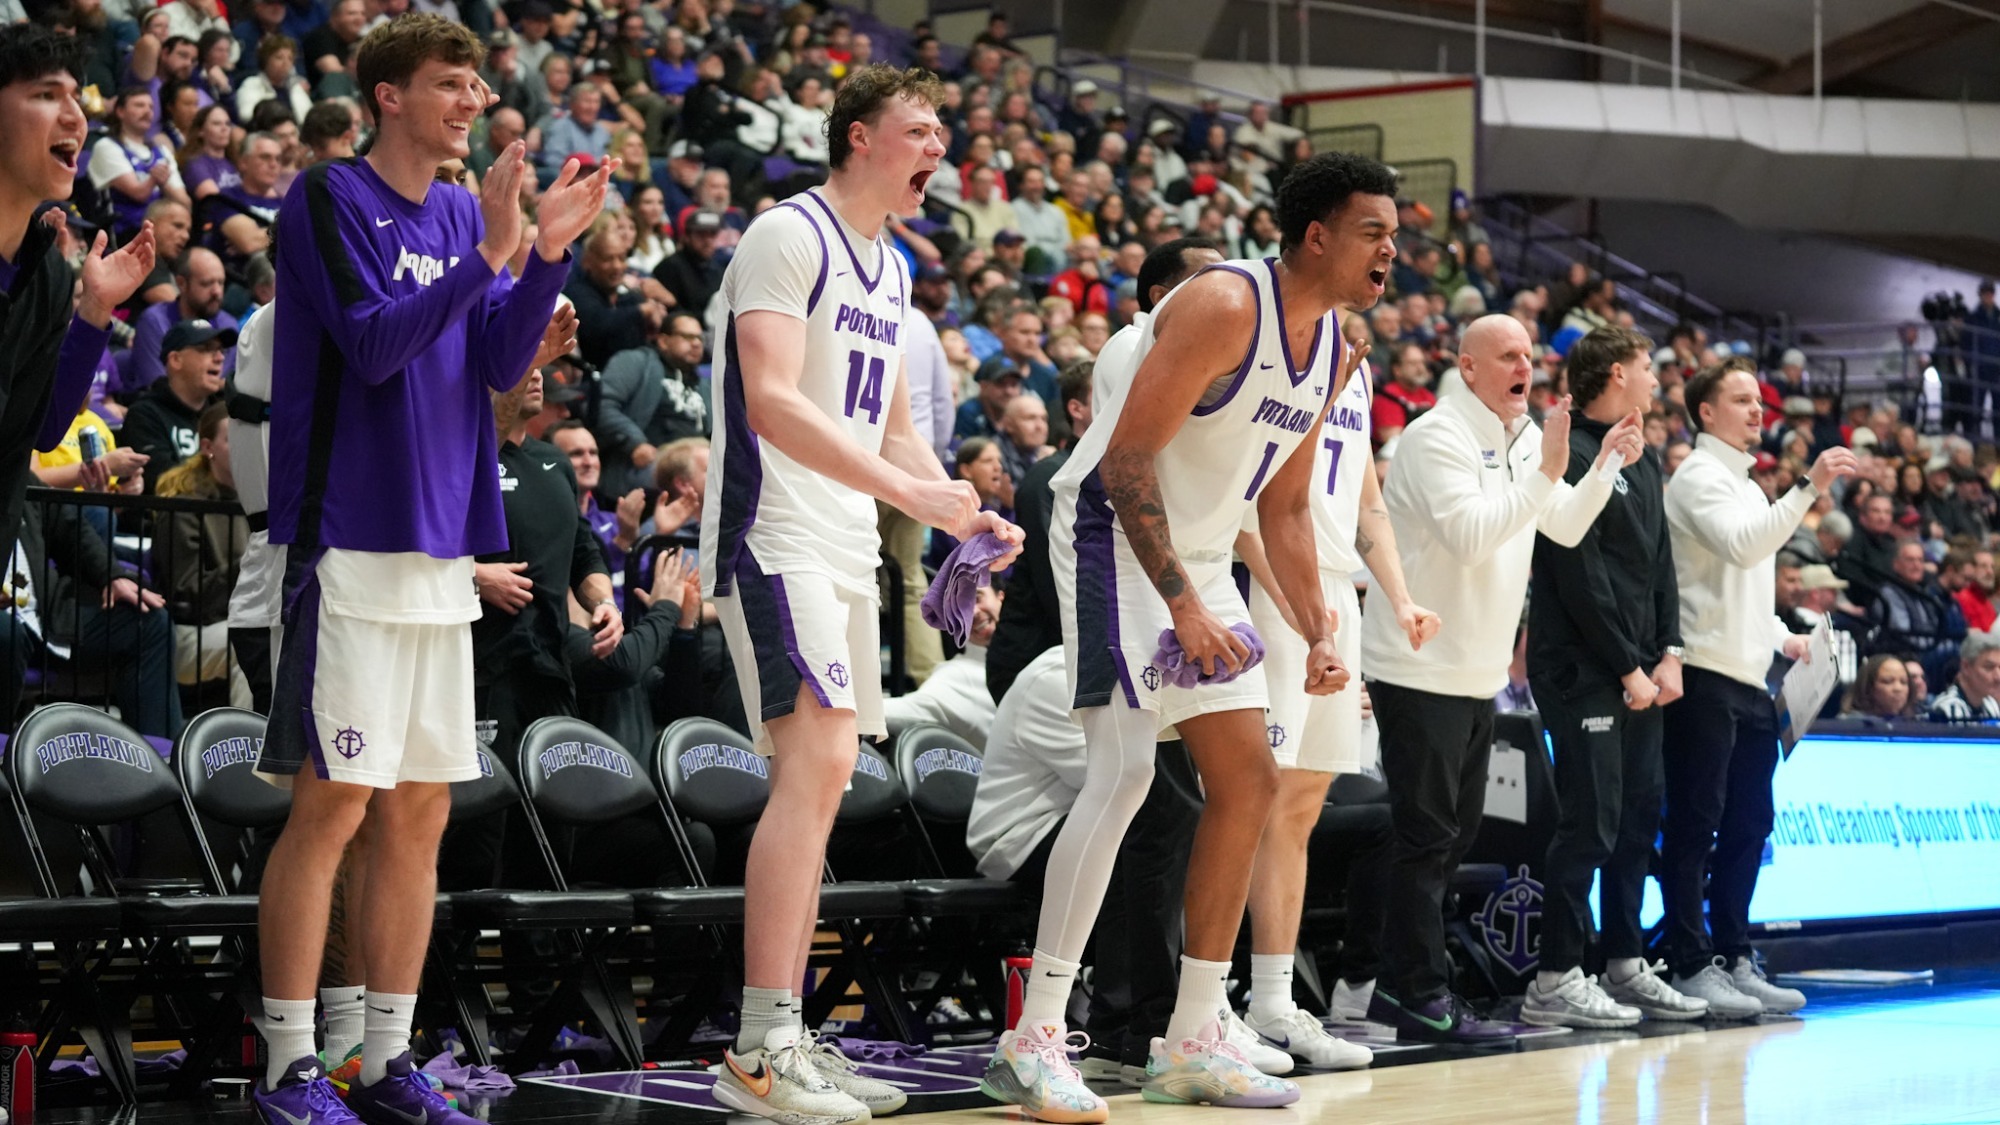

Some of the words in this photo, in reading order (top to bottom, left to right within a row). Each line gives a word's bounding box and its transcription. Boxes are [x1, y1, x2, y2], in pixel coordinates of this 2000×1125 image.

[834, 303, 898, 346] PORTLAND
[844, 349, 885, 425] 14
[1251, 396, 1314, 434] PORTLAND
[1244, 441, 1279, 501] 1
[1324, 438, 1343, 495] 7
[36, 732, 152, 774] PORTLAND
[202, 737, 262, 779] PORTL
[539, 741, 632, 780] PORTLAND
[678, 743, 768, 781] PORTLAND
[1774, 802, 1821, 845] icial
[1818, 800, 1900, 848] Cleaning
[1895, 802, 1964, 848] Sponsor
[1964, 801, 1984, 841] of
[1981, 801, 2000, 840] th
